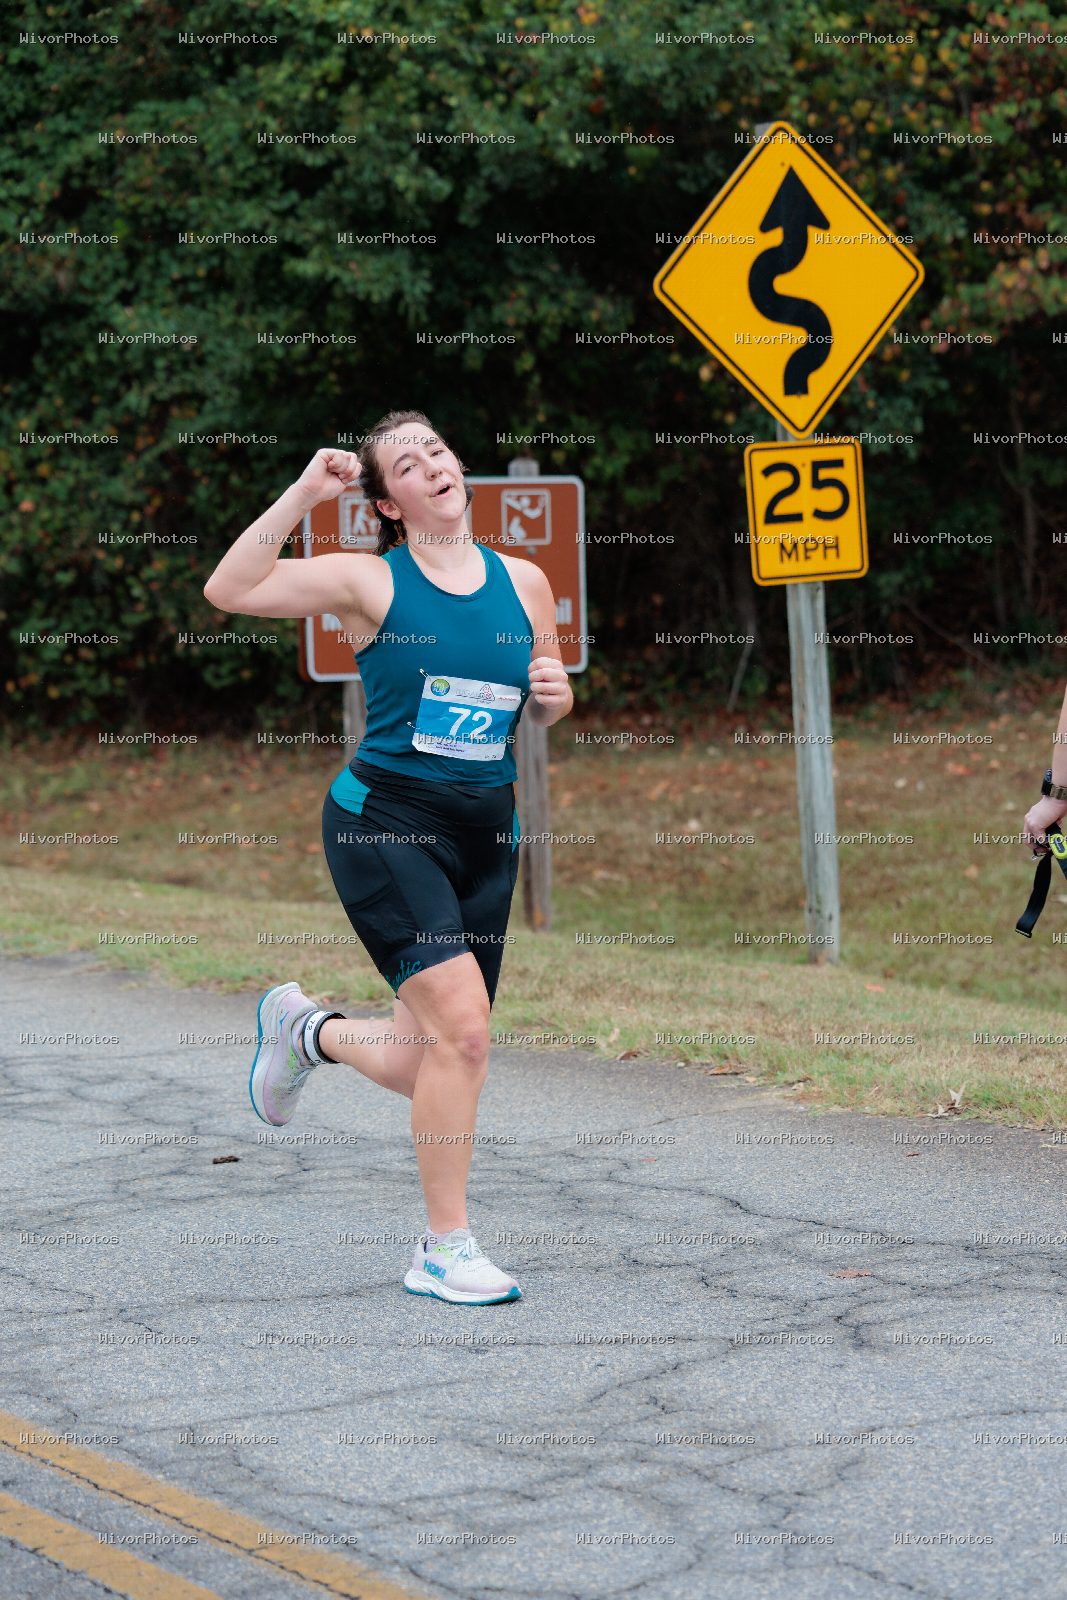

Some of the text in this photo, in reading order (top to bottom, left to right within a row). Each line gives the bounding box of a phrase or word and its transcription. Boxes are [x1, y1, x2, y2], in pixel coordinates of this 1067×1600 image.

[761, 459, 850, 525] 25
[779, 536, 841, 564] MPH
[448, 706, 493, 741] 72
